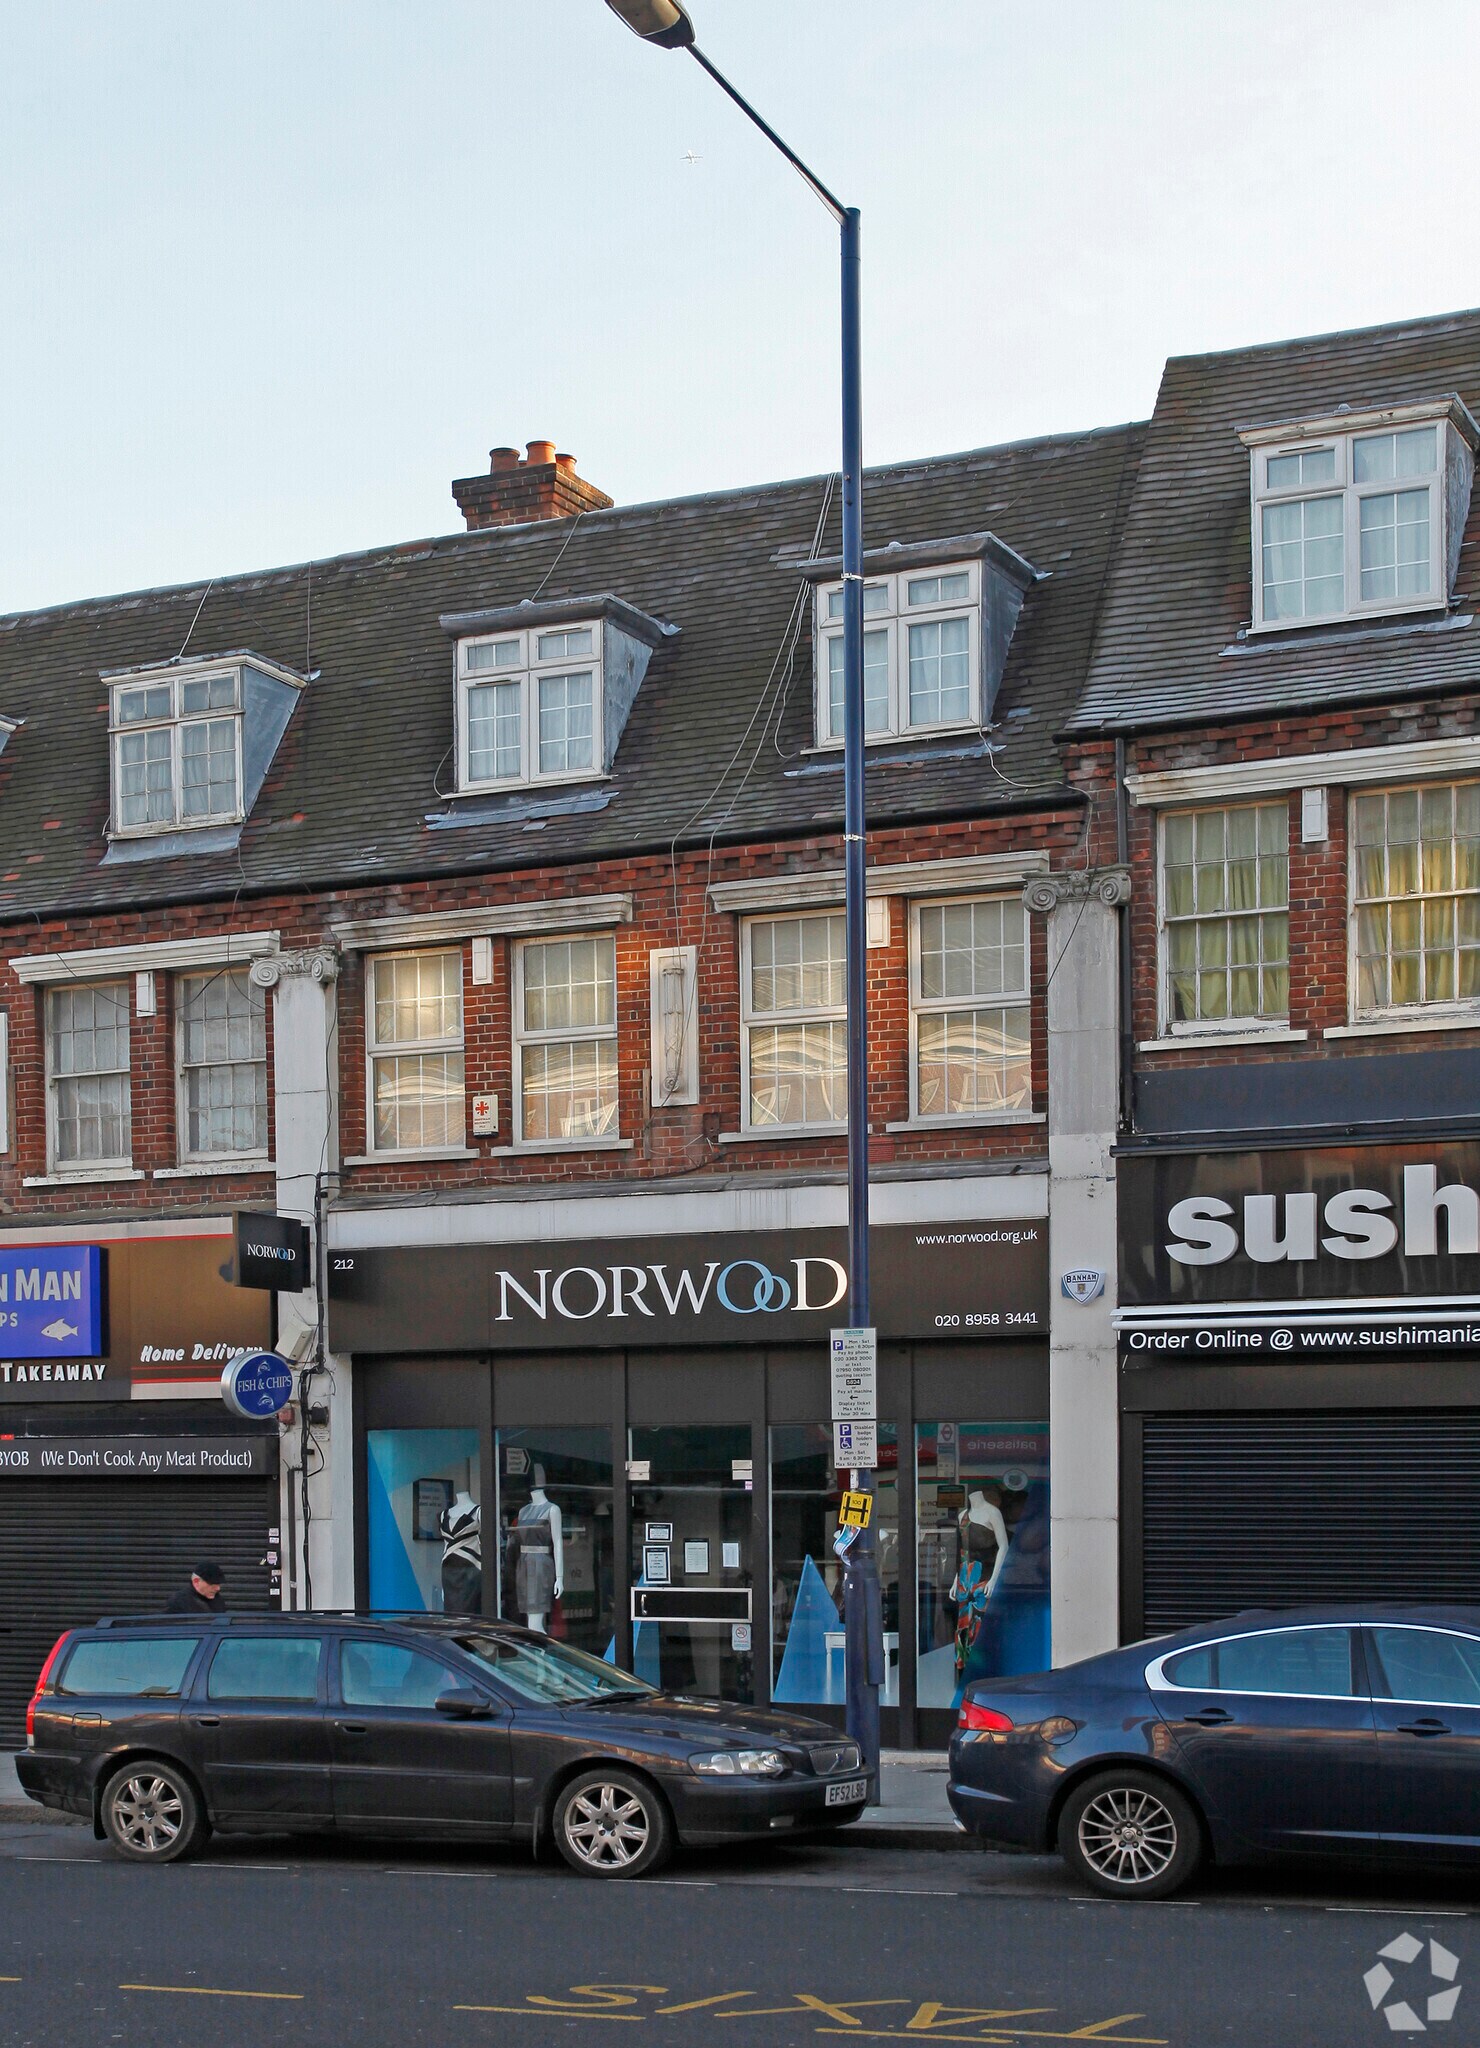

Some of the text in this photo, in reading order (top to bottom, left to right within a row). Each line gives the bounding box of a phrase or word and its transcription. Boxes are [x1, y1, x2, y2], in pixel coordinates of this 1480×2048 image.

[1164, 1164, 1480, 1266] sush
[916, 1229, 1038, 1245] www.norwood.org.uk
[247, 1243, 296, 1261] NORWOOD
[333, 1259, 354, 1270] 212
[15, 1268, 81, 1301] MAN
[1066, 1274, 1097, 1283] BANHAM
[494, 1257, 849, 1320] NORWOOD
[934, 1312, 1038, 1327] 020 8958 3441
[1129, 1325, 1480, 1350] Order Online @ www.sushimania
[140, 1343, 263, 1362] Home Delive
[1, 1363, 106, 1382] TAKEAWAY
[237, 1375, 292, 1393] FISH & CHIPS
[41, 1450, 252, 1471] (We Don't Cook Any Meat Product)
[526, 1985, 1168, 2044] TAXIS
